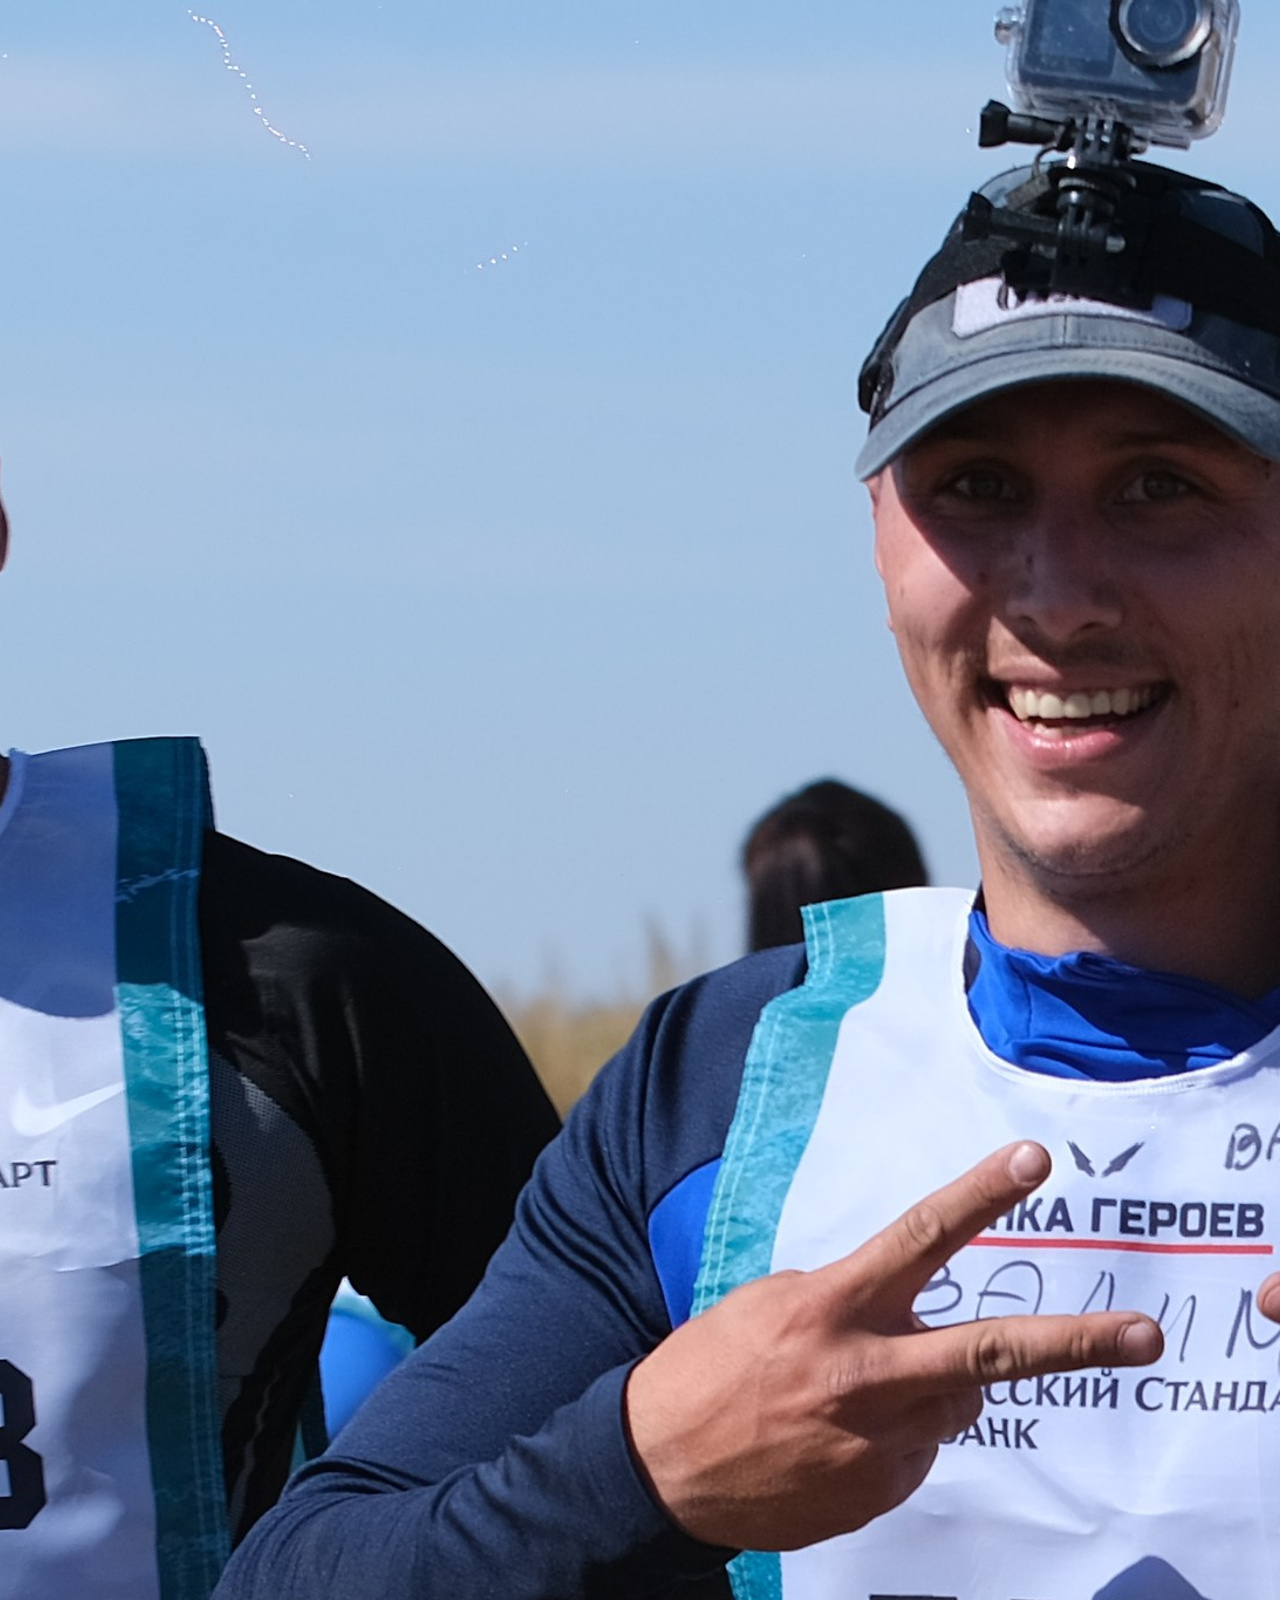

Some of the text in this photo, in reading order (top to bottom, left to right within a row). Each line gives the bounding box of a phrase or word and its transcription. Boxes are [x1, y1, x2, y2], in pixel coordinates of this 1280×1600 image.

[1091, 1197, 1265, 1238] ГЕРОЕВ
[983, 1367, 1120, 1410] ССКИЙ
[938, 1416, 1040, 1450] АНК
